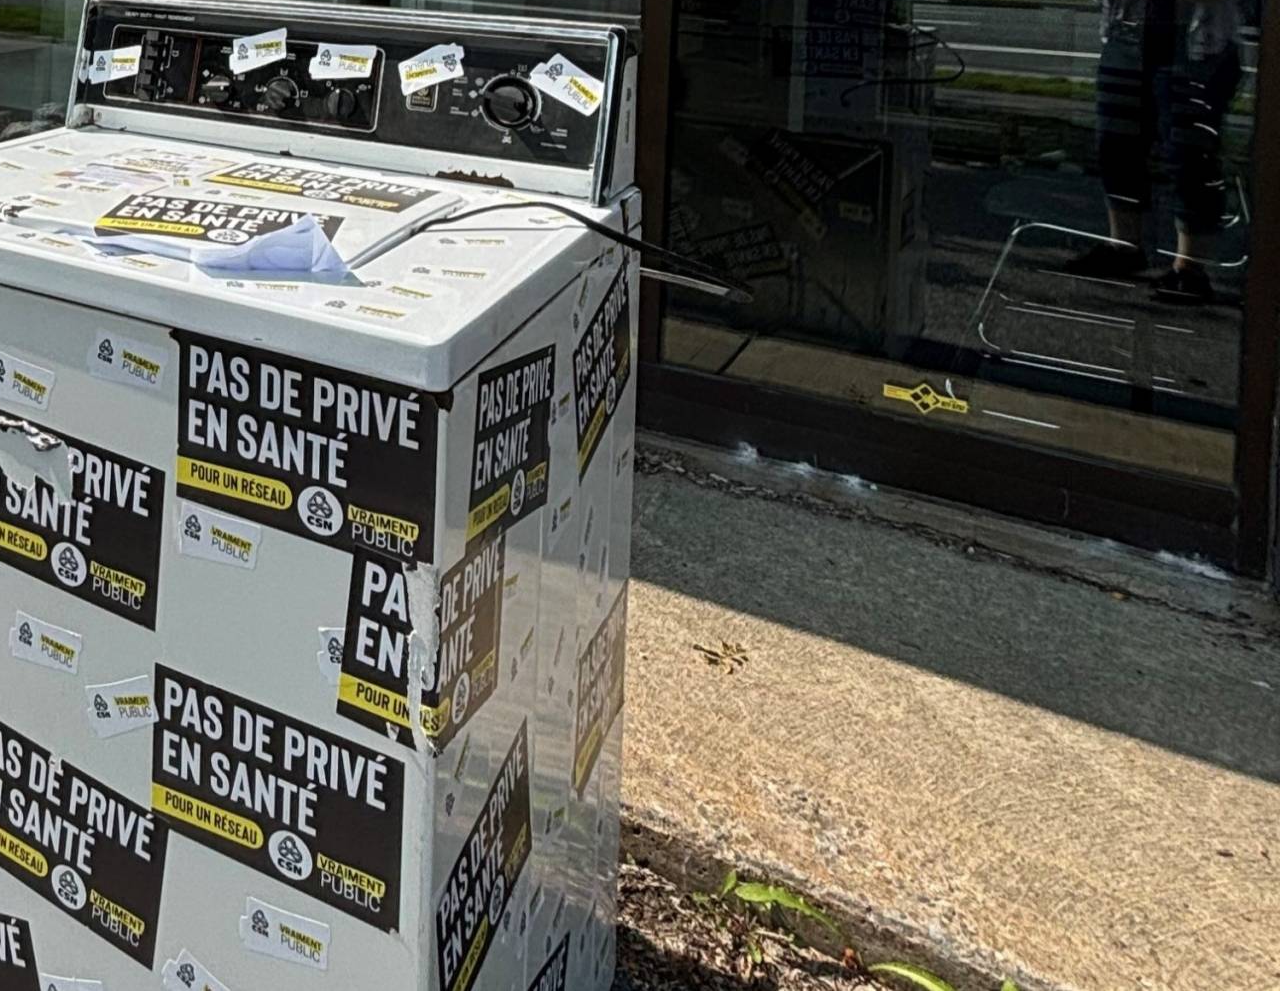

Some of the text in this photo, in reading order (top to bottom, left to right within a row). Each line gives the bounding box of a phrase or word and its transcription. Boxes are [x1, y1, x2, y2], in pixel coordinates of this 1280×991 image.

[232, 170, 266, 182] EN
[249, 164, 301, 176] PAS
[301, 171, 341, 183] DE
[117, 205, 161, 219] EN
[129, 196, 232, 214] PAS DE
[576, 335, 593, 391] PAS
[593, 313, 605, 356] DE
[122, 361, 156, 384] PUBLIC
[479, 348, 552, 431] PAS DE PRIVÉ
[12, 380, 44, 405] PUBLIC
[189, 345, 420, 450] PAS DE PRIVÉ
[579, 391, 590, 434] EN
[188, 399, 348, 488] EN SANTÉ
[474, 438, 493, 491] EN
[494, 409, 531, 479] SANTÉ
[69, 447, 150, 517] PRIVÉ
[191, 463, 286, 507] POUR UN RÉSEAU
[6, 480, 93, 545] SANTÉ
[307, 517, 333, 532] CSN
[350, 508, 418, 538] VRAIMENT
[7, 527, 43, 557] RÉSEAU
[185, 529, 201, 542] CSN
[211, 526, 253, 550] VRAIMENT
[211, 537, 249, 563] PUBLIC
[352, 524, 414, 557] PUBLIC
[58, 568, 79, 583] CSN
[92, 562, 144, 592] VRAIMENT
[92, 575, 142, 610] PUBLIC
[361, 525, 502, 633] PA DE PRIVÉ
[41, 643, 73, 668] PUBLIC
[356, 605, 475, 694] EN ANTÉ
[118, 706, 152, 719] PUBLIC
[356, 682, 390, 711] POUR
[394, 699, 410, 722] UN
[163, 677, 387, 811] PAS DE PRIVÉ
[162, 731, 319, 837] EN SANTÉ
[29, 751, 63, 806] DE
[70, 776, 155, 862] PRIVÉ
[165, 792, 258, 845] POUR UN RÉSEAU
[8, 788, 95, 875] SANTÉ
[8, 836, 44, 874] RÉSEAU
[277, 857, 303, 876] CSN
[319, 857, 384, 895] VRAIMENT
[320, 872, 381, 913] PUBLIC
[441, 857, 468, 939] PAS
[471, 816, 488, 878] DE
[57, 887, 79, 906] CSN
[92, 891, 144, 932] VRAIMENT
[92, 906, 141, 948] PUBLIC
[252, 924, 268, 938] CSN
[279, 923, 323, 950] VRAIMENT
[280, 935, 320, 963] PUBLIC
[443, 927, 463, 989] EN
